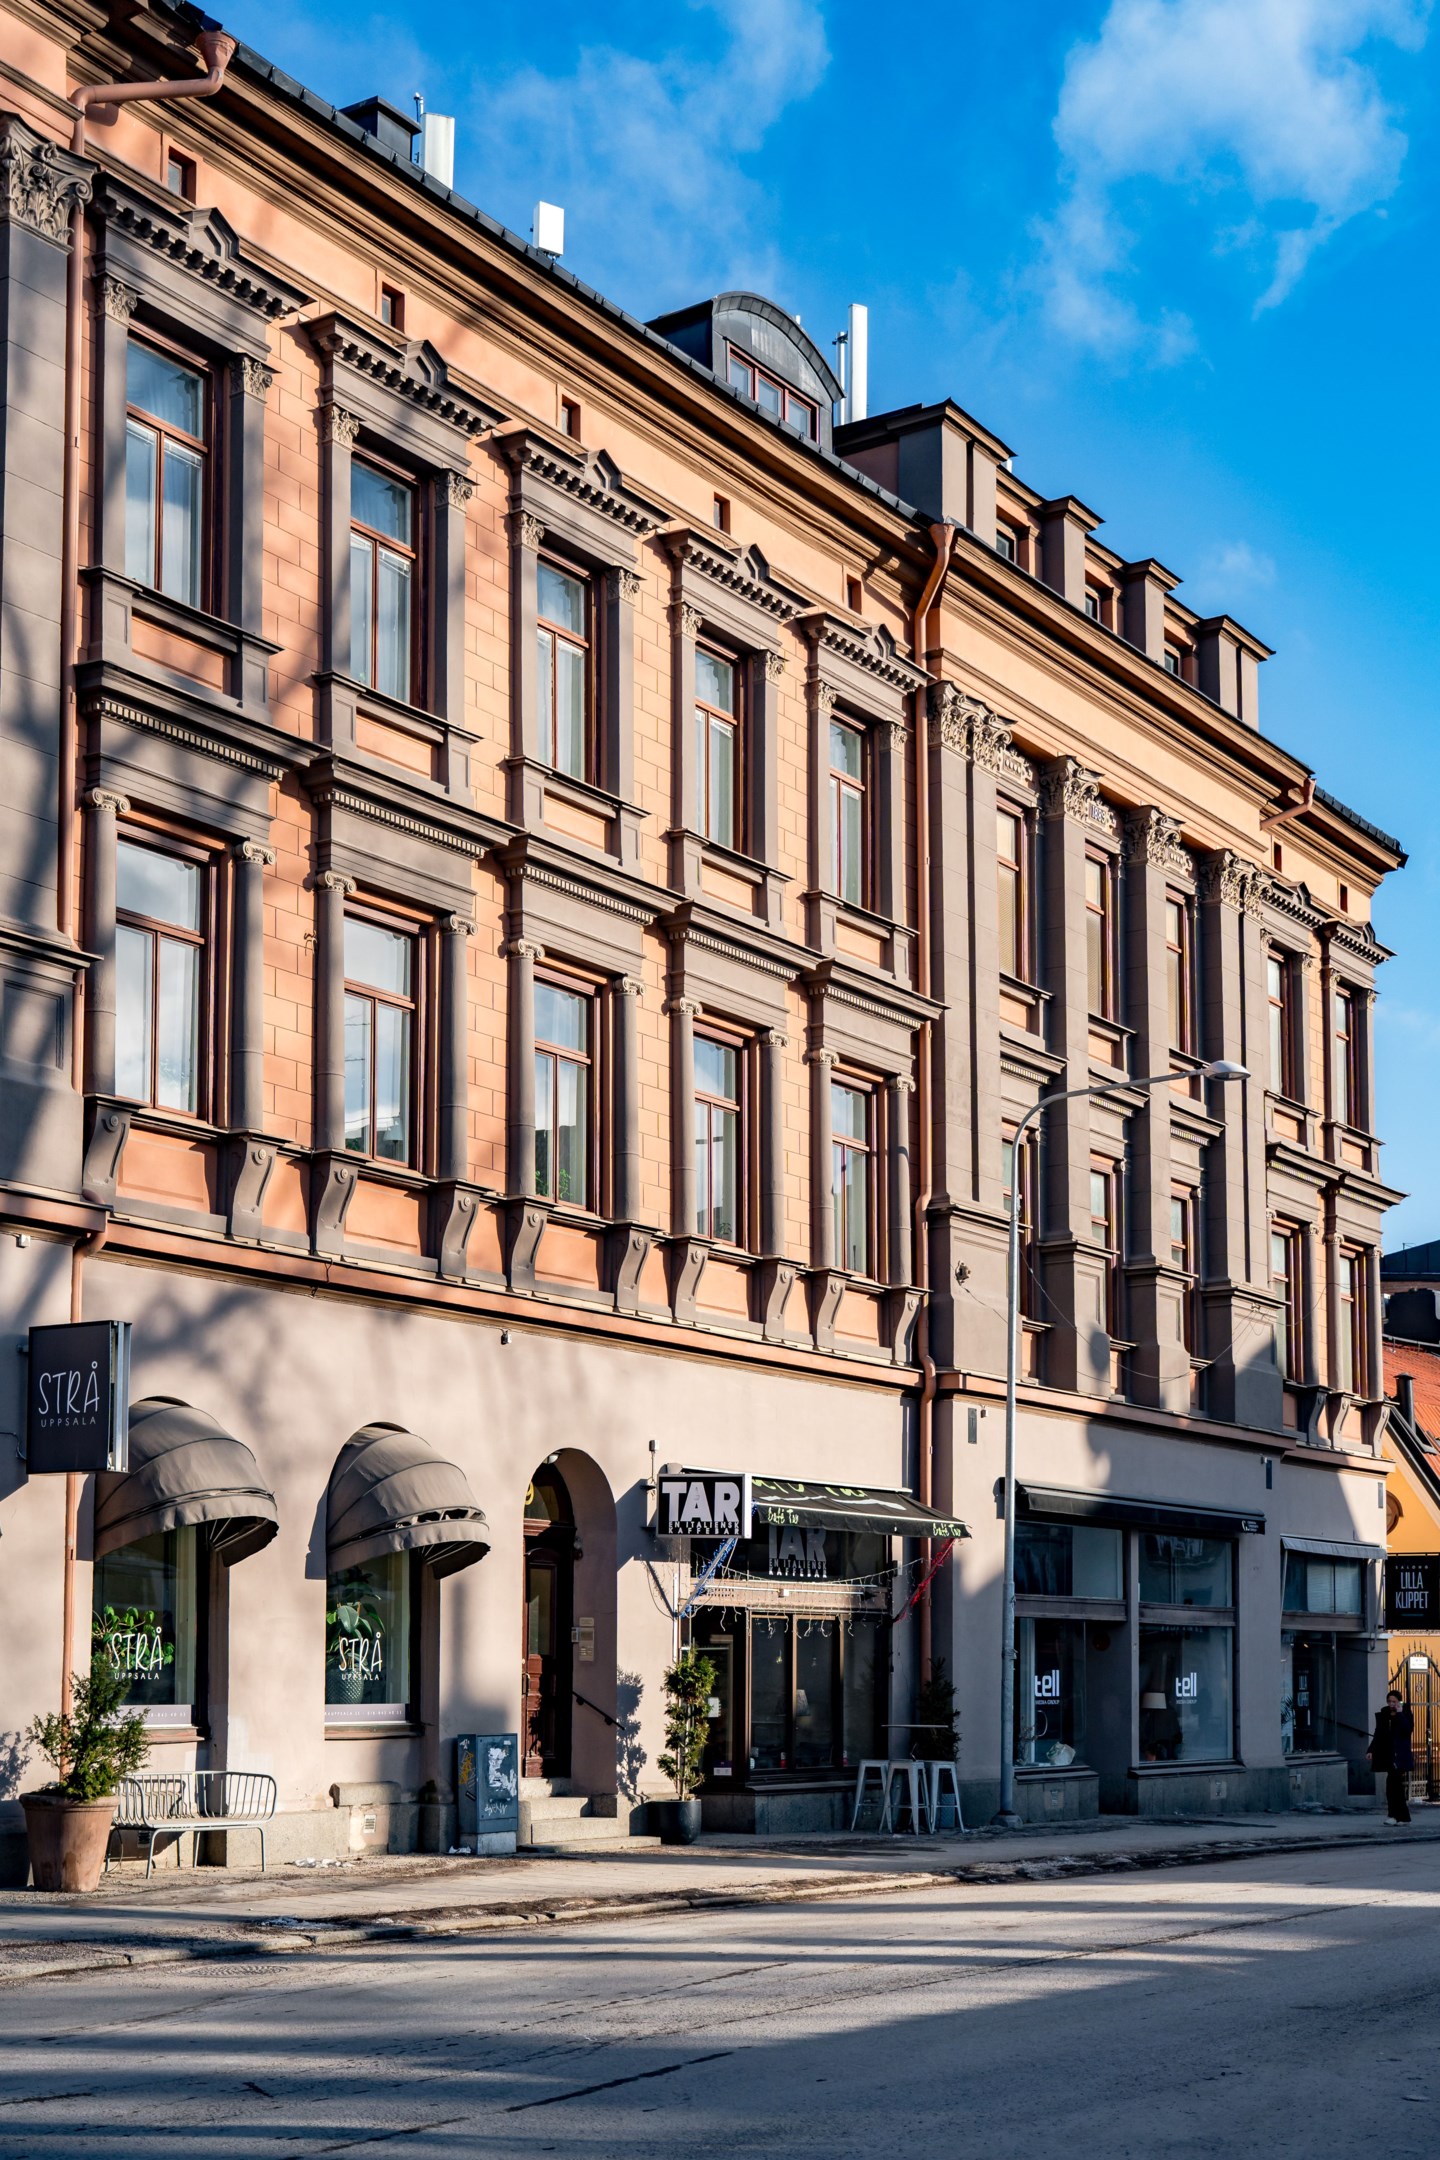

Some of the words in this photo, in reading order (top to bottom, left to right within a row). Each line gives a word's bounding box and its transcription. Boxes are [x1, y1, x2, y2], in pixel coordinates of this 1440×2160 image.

[38, 1361, 100, 1415] STRÅ
[41, 1416, 96, 1428] UPPSALA
[662, 1481, 740, 1522] TAR
[668, 1527, 739, 1535] KAFFEBAR
[1400, 1571, 1424, 1590] LILLA
[1395, 1591, 1429, 1609] KLIPPET
[109, 1626, 164, 1671] STRÅ
[338, 1631, 383, 1672] STRÅ
[114, 1672, 160, 1680] UPPSALA
[341, 1673, 380, 1681] UPPSALA
[1034, 1669, 1060, 1697] tell
[1175, 1672, 1197, 1697] tell
